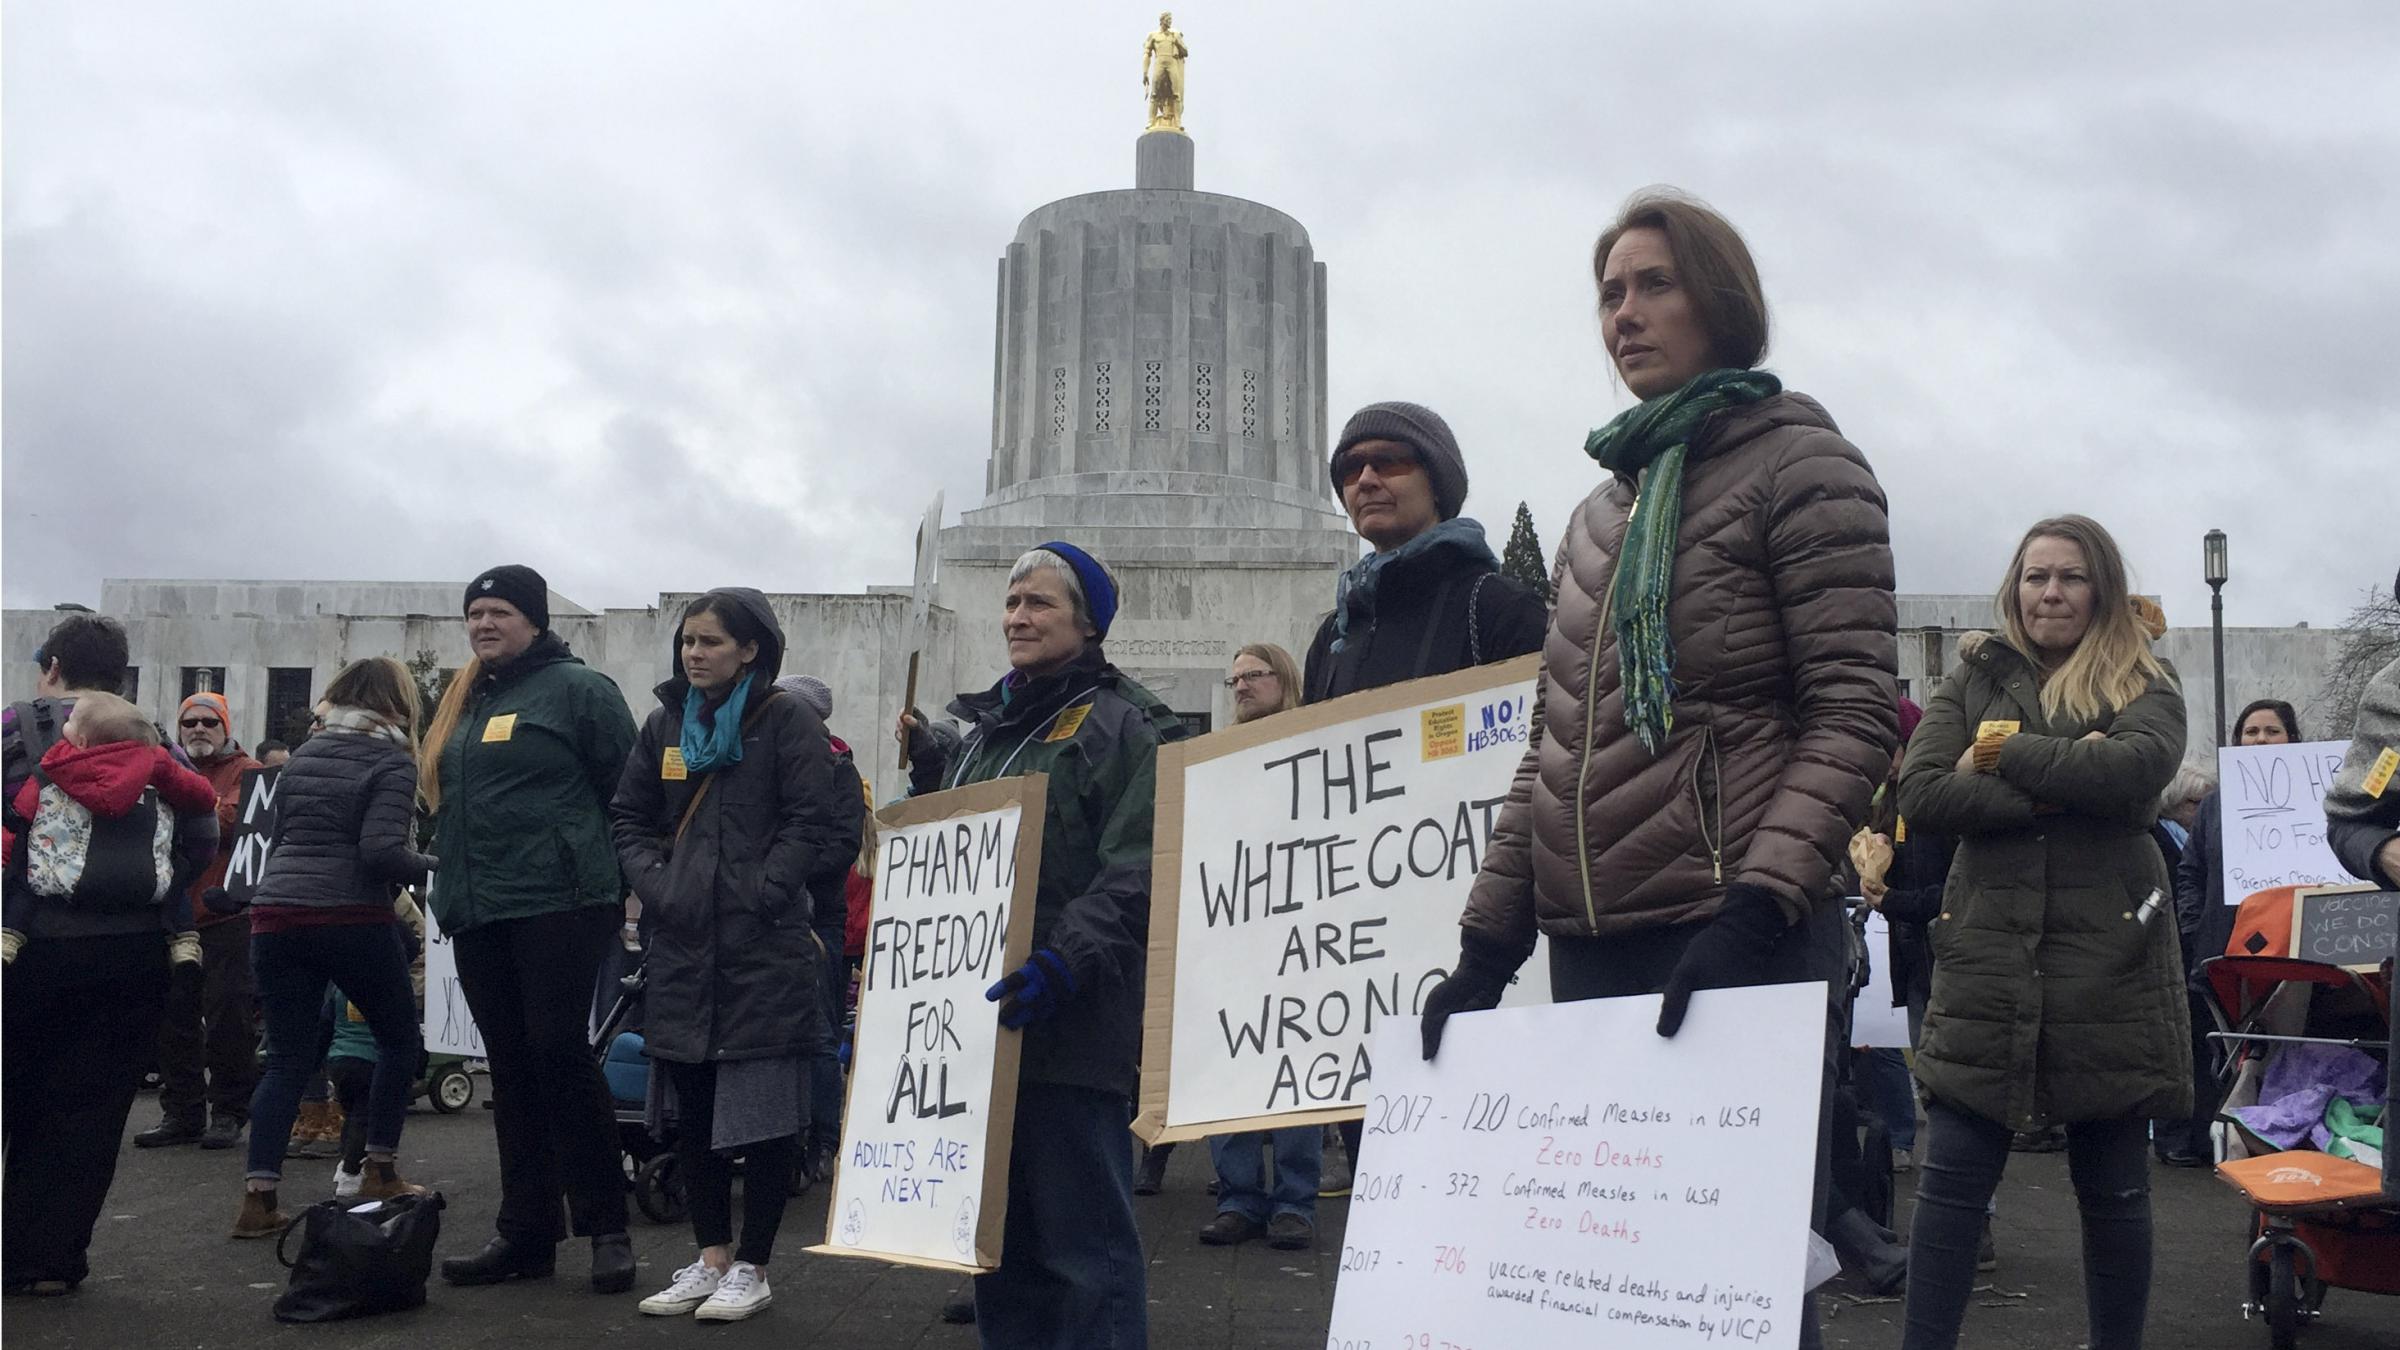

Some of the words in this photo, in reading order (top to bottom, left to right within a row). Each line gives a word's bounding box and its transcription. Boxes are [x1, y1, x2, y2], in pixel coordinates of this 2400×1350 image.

[1264, 728, 1406, 820] THE
[2237, 755, 2291, 808] NO
[223, 832, 272, 892] MY
[2246, 824, 2282, 853] NO
[1200, 834, 1360, 928] WHITE
[2229, 868, 2282, 890] Parents
[1277, 916, 1387, 976] ARE
[2309, 917, 2348, 934] WE
[2358, 914, 2388, 930] DO
[905, 998, 962, 1052] FOR
[1368, 1094, 1432, 1134] 2017
[1462, 1093, 1510, 1132] 120
[1602, 1103, 1671, 1124] Measles
[1690, 1112, 1706, 1126] in
[1719, 1106, 1761, 1128] USA
[853, 1140, 915, 1172] ADULTS
[928, 1138, 968, 1171] ARE
[1536, 1136, 1582, 1166] Zero
[1594, 1141, 1664, 1168] Deaths
[1354, 1172, 1403, 1202] 2018
[1446, 1173, 1480, 1197] 372
[1502, 1172, 1566, 1199] Confirmed
[1577, 1181, 1636, 1202] Measles
[1654, 1189, 1668, 1201] in
[1686, 1186, 1720, 1206] USA
[1524, 1207, 1562, 1230] Zero
[1578, 1210, 1641, 1242] Deaths
[1341, 1246, 1381, 1272] 2017
[1433, 1246, 1466, 1274] 706
[1556, 1269, 1612, 1292] related
[1618, 1274, 1669, 1301] deaths
[1676, 1283, 1708, 1304] and
[1714, 1285, 1772, 1311] injuries
[1487, 1286, 1534, 1304] awarded
[1540, 1289, 1598, 1317] financial
[1608, 1307, 1691, 1329] compensation
[1698, 1315, 1715, 1341] by
[1721, 1318, 1771, 1344] VICP
